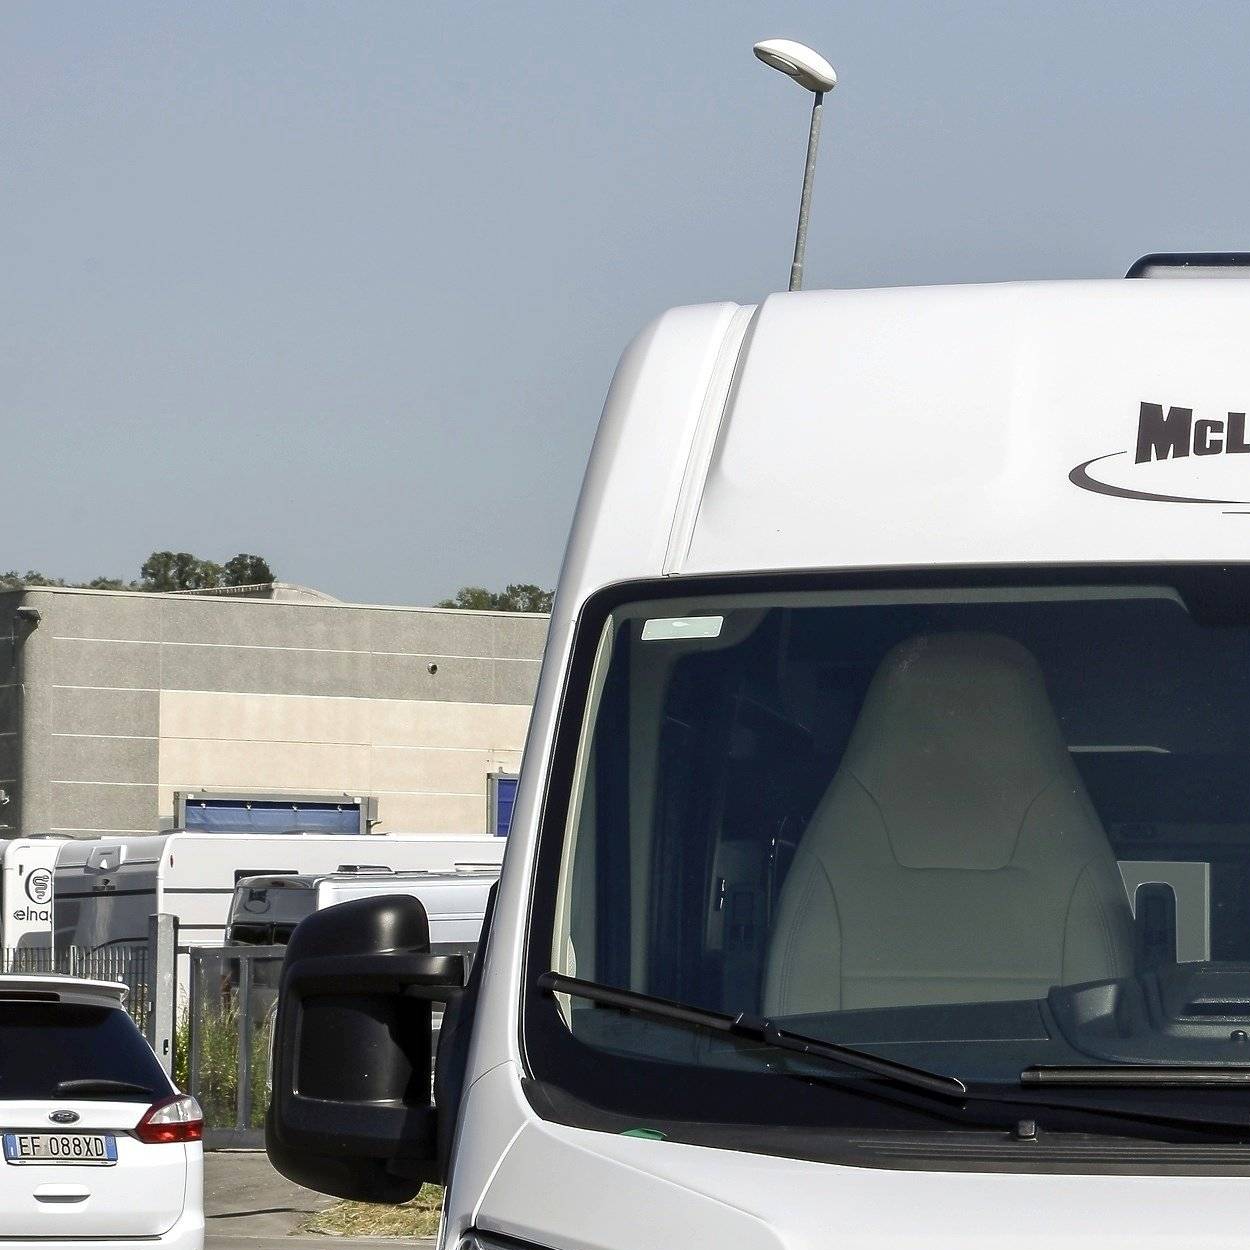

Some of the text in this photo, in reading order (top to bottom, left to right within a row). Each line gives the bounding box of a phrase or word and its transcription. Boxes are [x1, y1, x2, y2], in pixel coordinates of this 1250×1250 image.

[13, 905, 52, 925] elna
[19, 1136, 104, 1157] EF 088XD
